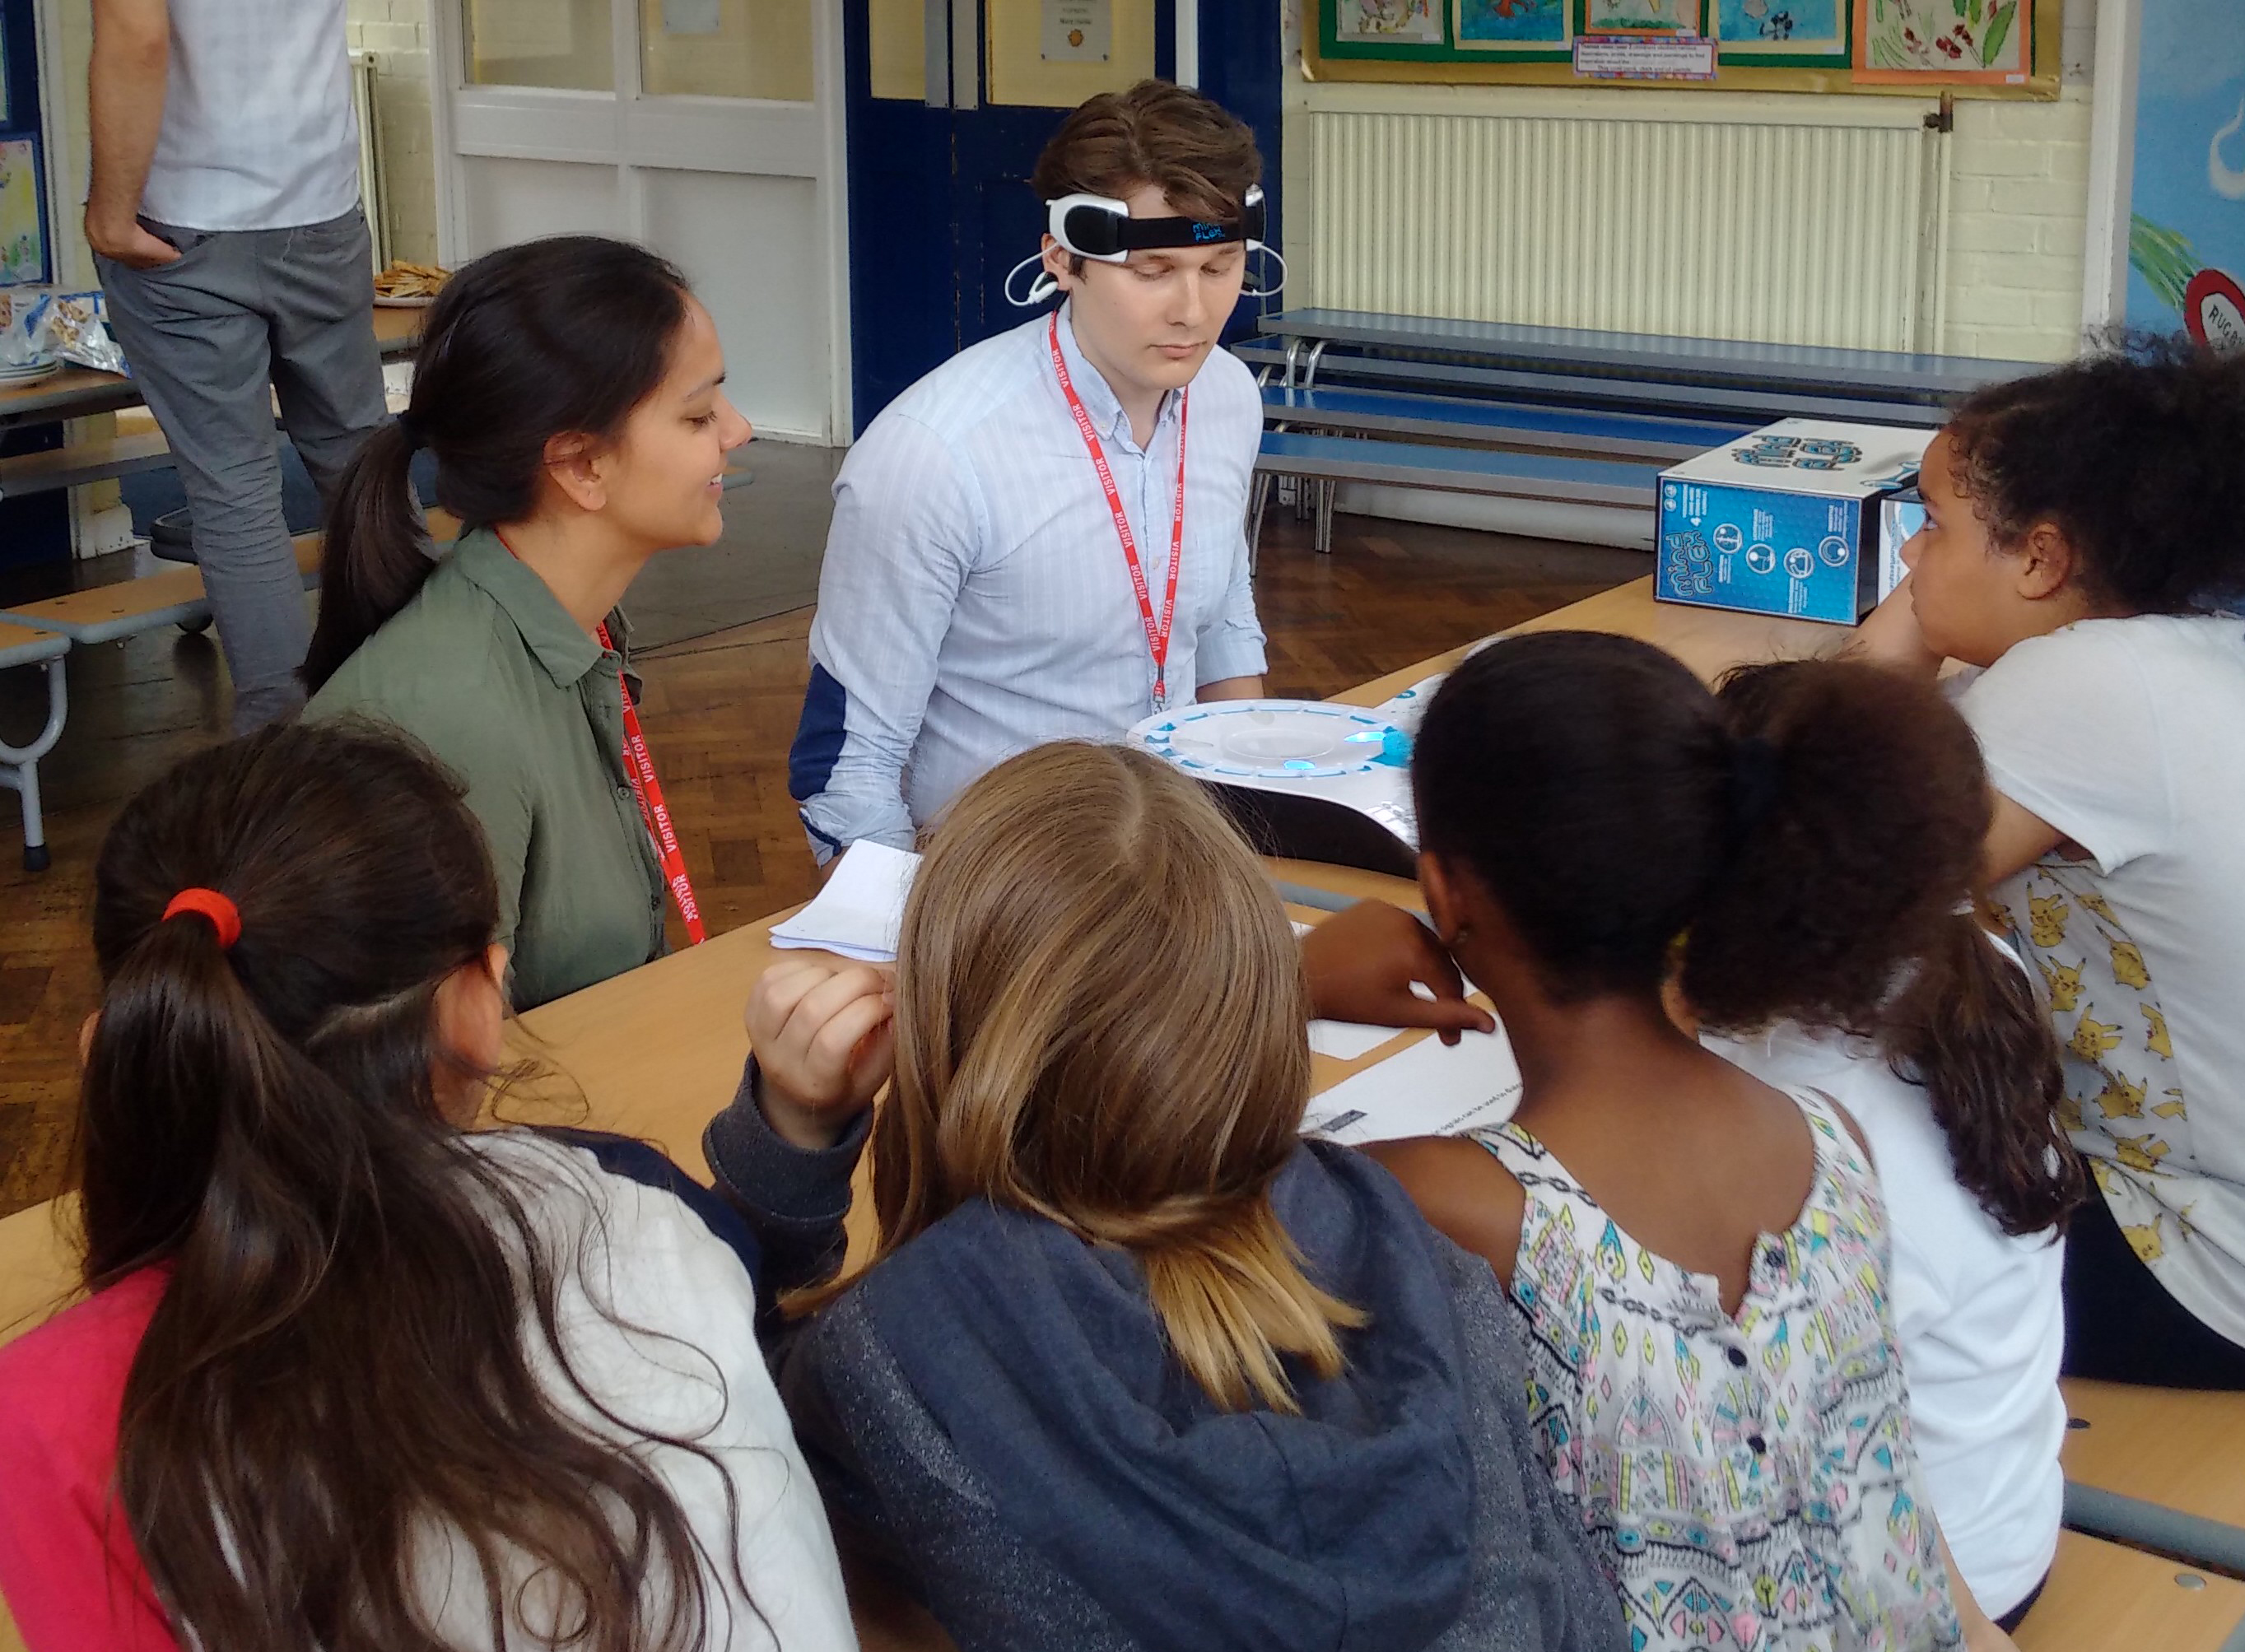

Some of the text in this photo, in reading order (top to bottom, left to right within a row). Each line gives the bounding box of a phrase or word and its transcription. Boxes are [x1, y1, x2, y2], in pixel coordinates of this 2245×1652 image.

[1052, 349, 1069, 388] VISITOR
[1073, 404, 1095, 441] VISITOR
[1095, 458, 1116, 496] VISITOR
[1175, 483, 1183, 523] VISITOR
[1114, 512, 1133, 548] VISITOR
[1169, 541, 1180, 580] VISITOR
[1130, 564, 1148, 600] VISITOR
[1144, 616, 1160, 652] VISITOR
[1159, 598, 1173, 638] VISITOR
[631, 734, 654, 783] VISITOR
[654, 803, 677, 854] VISITOR
